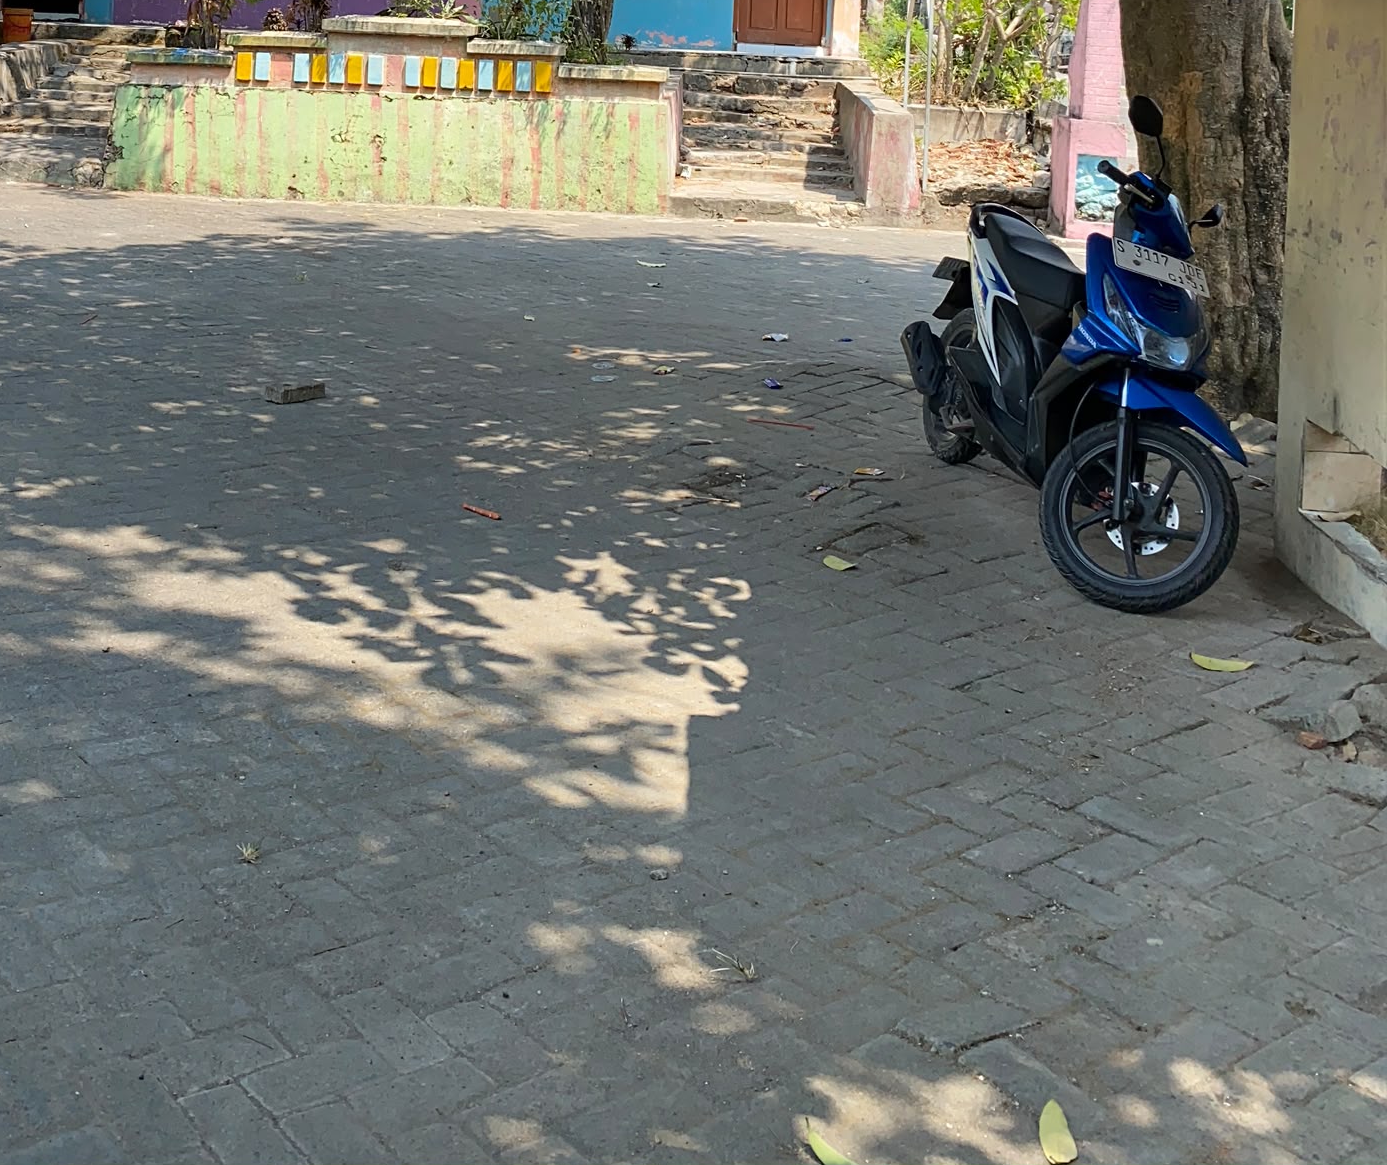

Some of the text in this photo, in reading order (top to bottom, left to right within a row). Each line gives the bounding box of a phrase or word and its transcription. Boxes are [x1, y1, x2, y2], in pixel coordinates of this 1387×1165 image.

[1116, 240, 1204, 280] S 3117 JDE
[1078, 322, 1096, 349] HONDA
